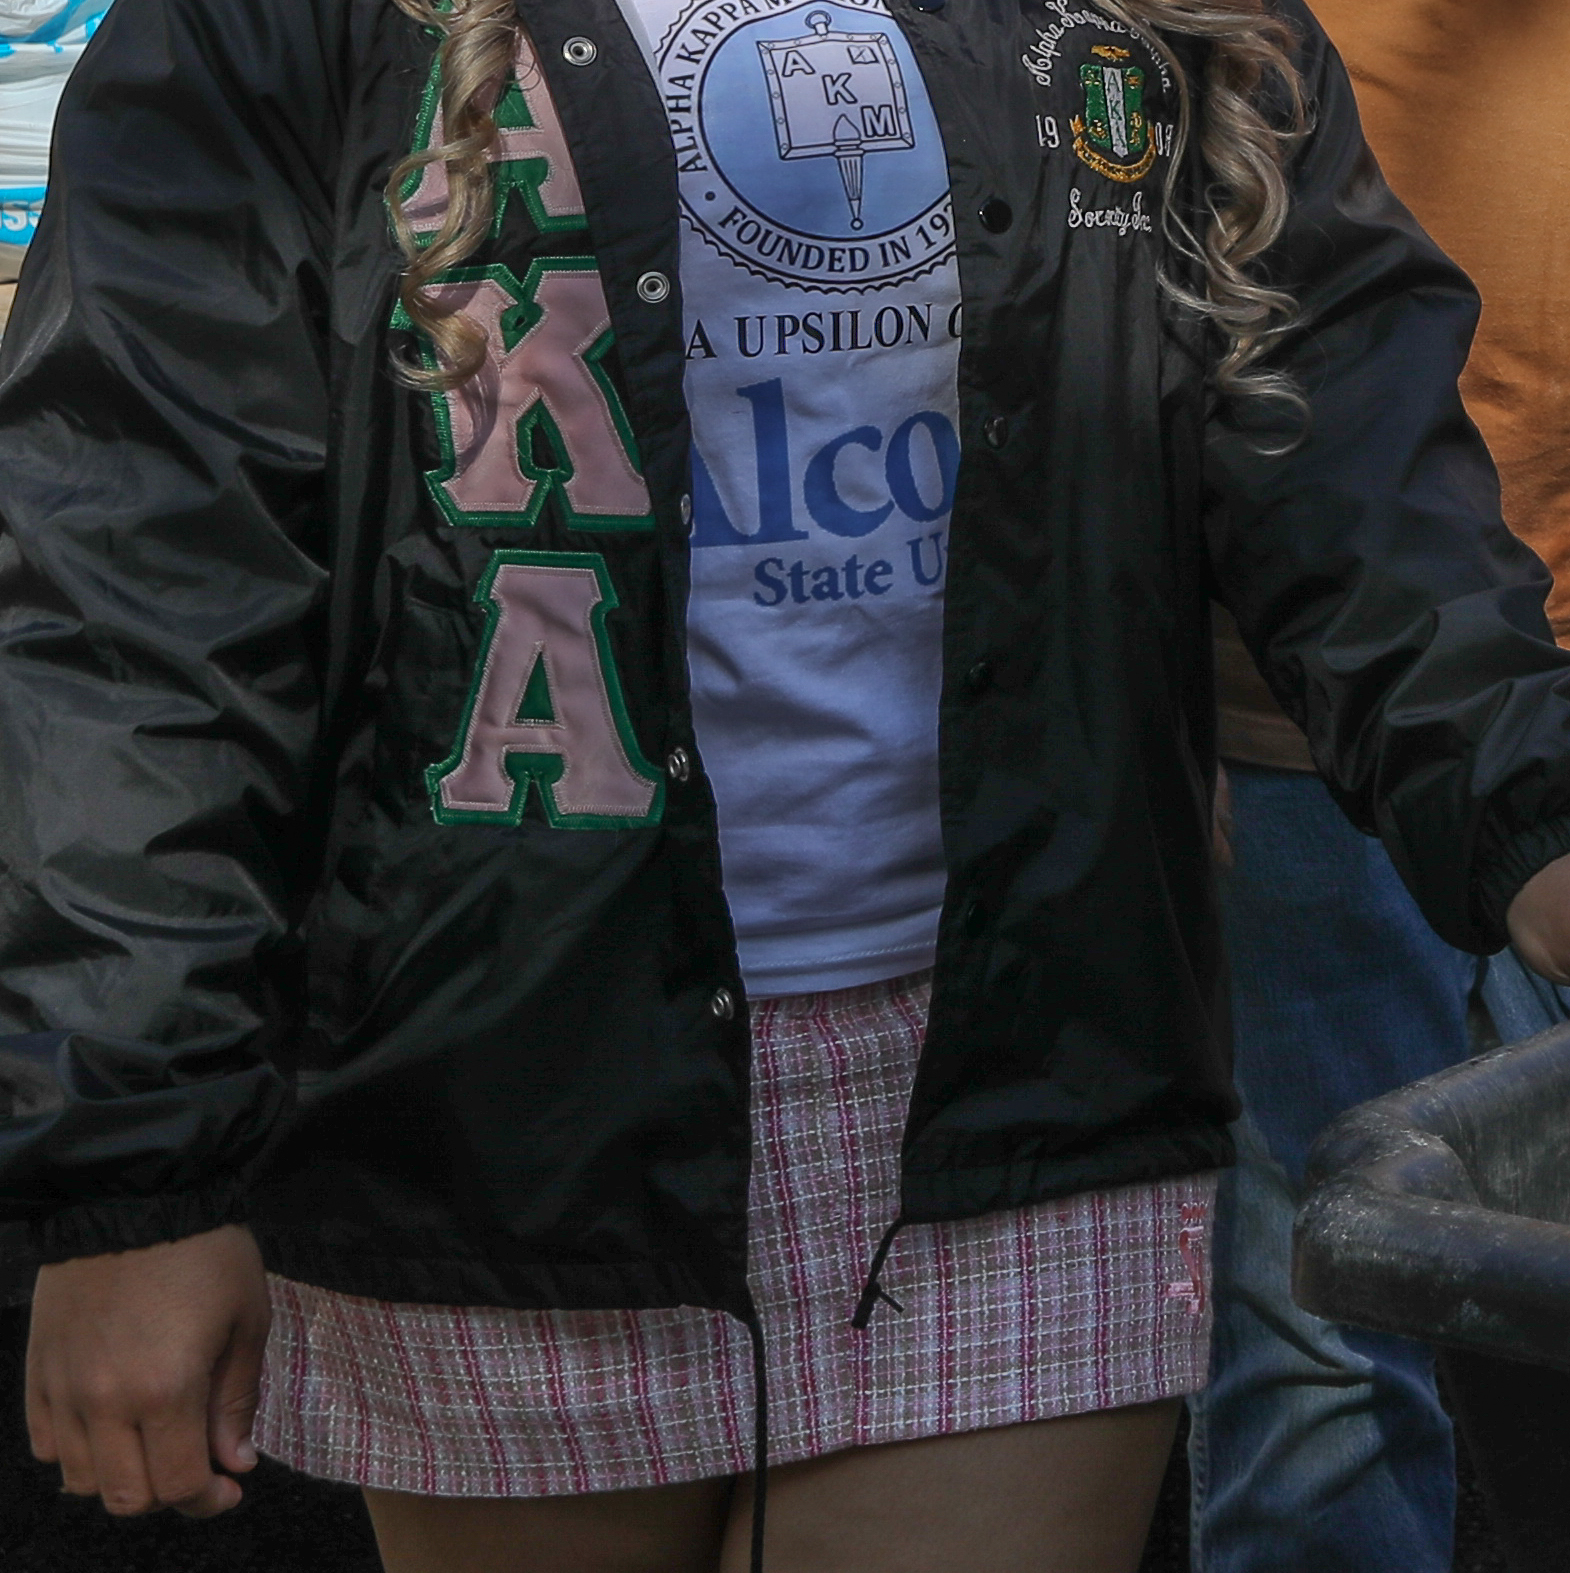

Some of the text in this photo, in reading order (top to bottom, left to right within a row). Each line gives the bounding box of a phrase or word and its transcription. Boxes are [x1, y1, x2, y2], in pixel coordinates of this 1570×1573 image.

[781, 49, 816, 78] A
[1022, 24, 1066, 87] Alpha
[821, 72, 858, 106] K
[666, 72, 709, 174] ALPHA
[860, 103, 897, 139] M
[1035, 114, 1061, 149] 19
[717, 206, 912, 274] FOUNDED IN
[733, 303, 932, 359] UPSILON
[753, 553, 894, 608] State
